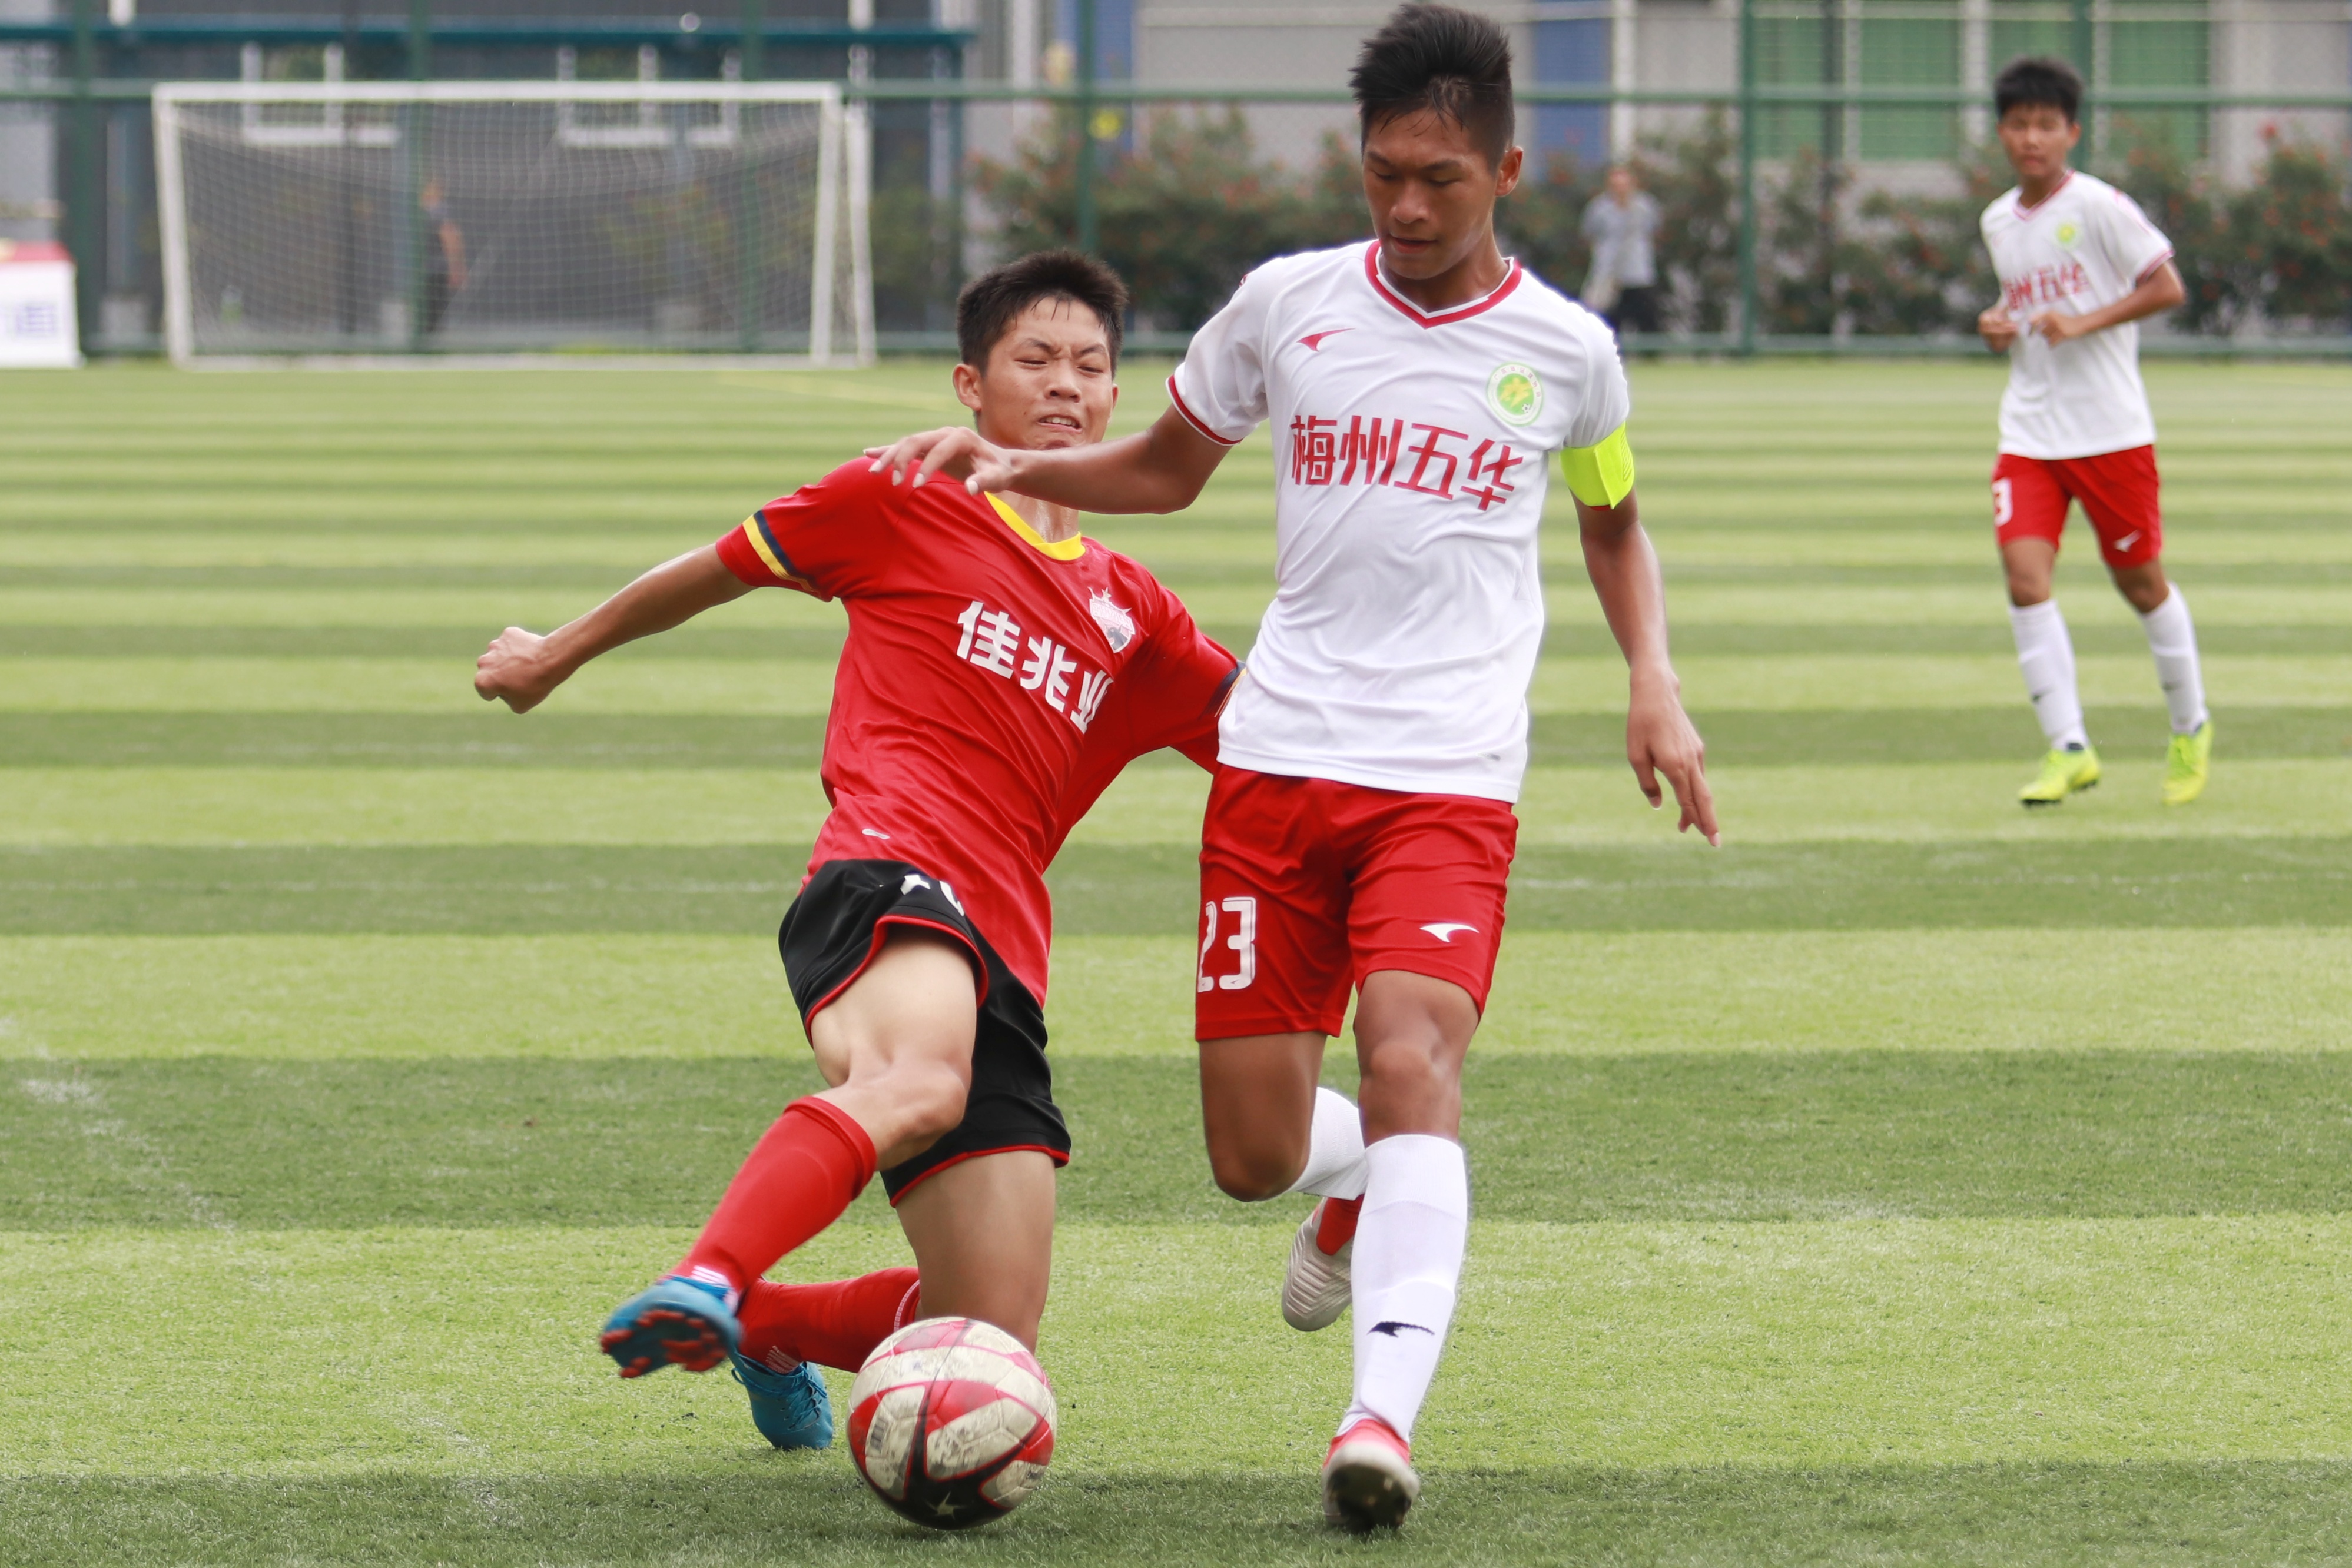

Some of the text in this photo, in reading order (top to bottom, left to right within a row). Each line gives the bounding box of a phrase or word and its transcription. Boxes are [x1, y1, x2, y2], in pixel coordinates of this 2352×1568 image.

[1291, 414, 1524, 511] 梅州五华
[956, 600, 1114, 734] 佳兆业
[1197, 896, 1256, 992] 23
